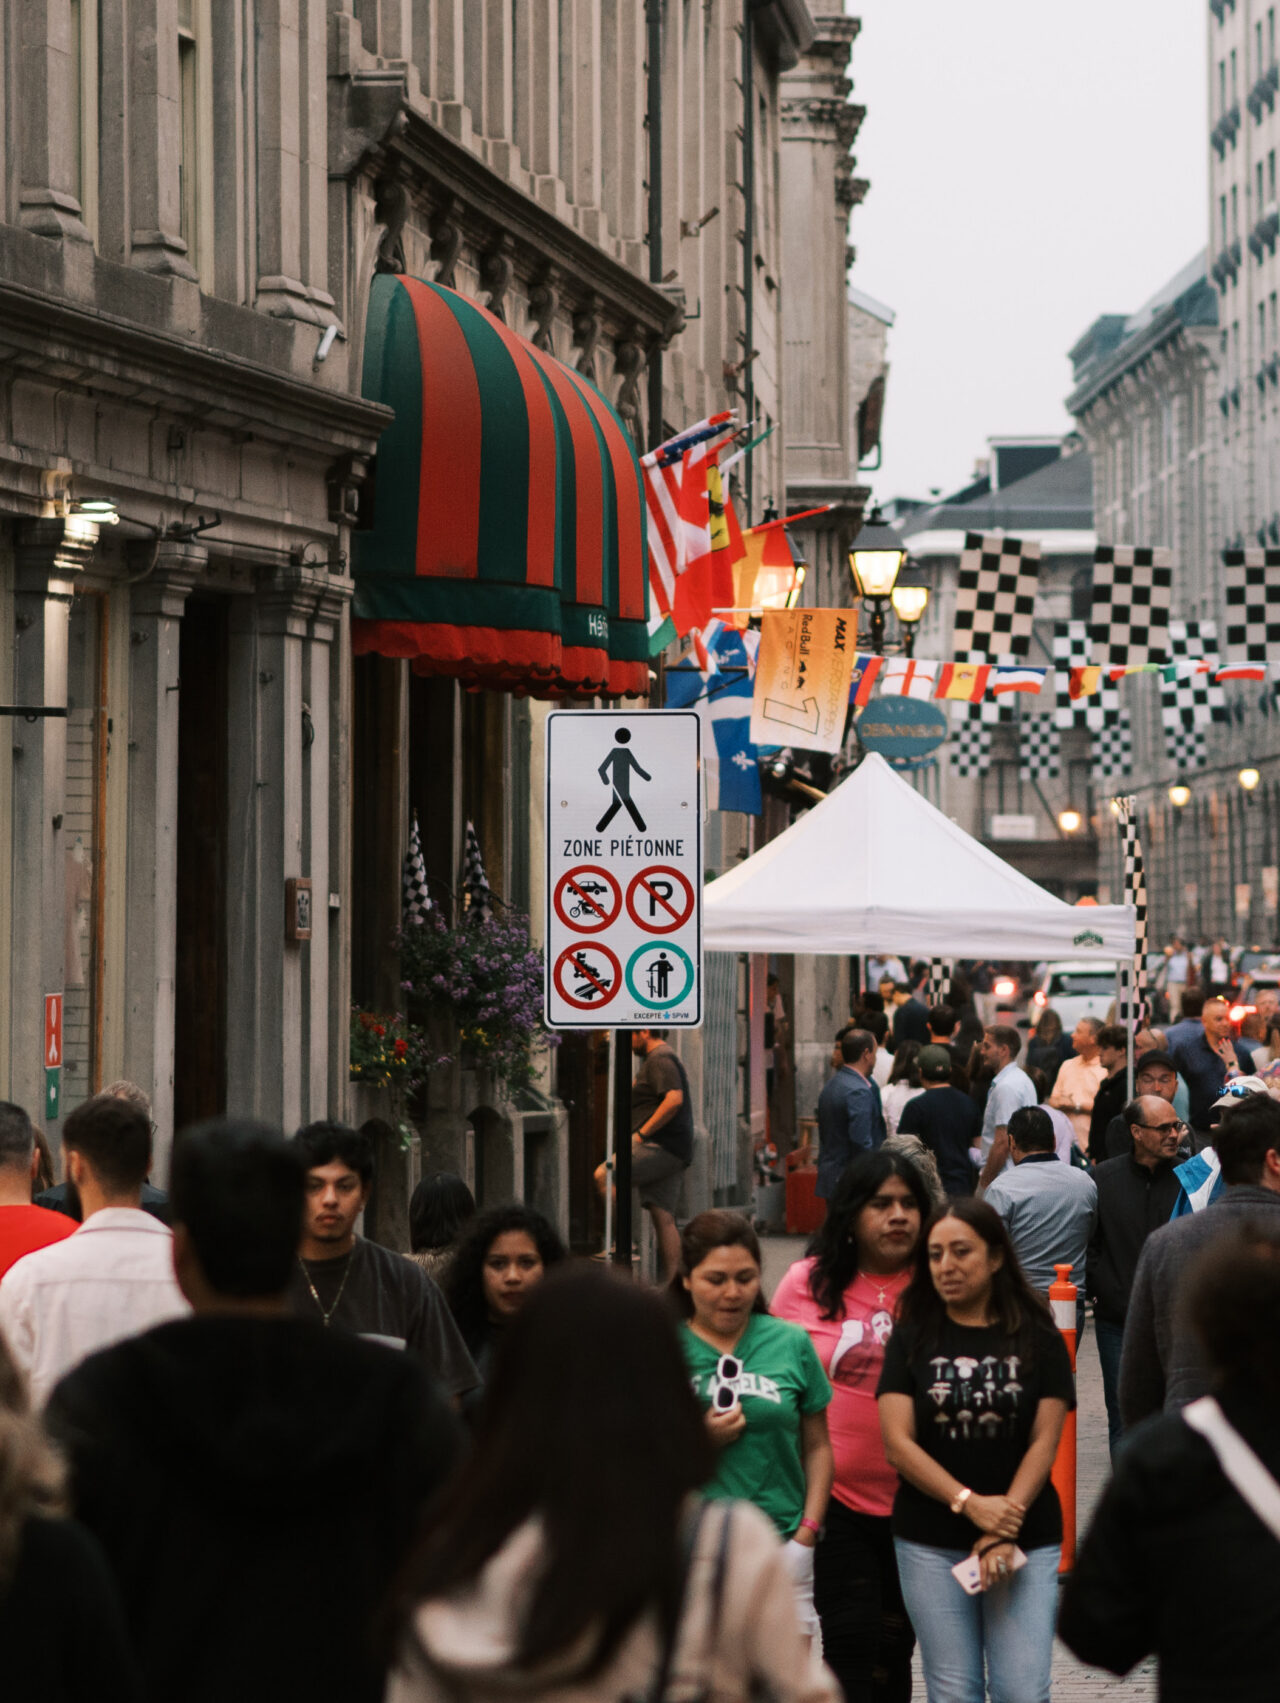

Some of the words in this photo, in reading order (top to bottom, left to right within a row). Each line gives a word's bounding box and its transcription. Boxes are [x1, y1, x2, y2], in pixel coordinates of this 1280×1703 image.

[834, 617, 847, 652] MAX
[563, 839, 602, 857] ZONE
[611, 834, 684, 857] PIÉTONNE
[649, 881, 674, 917] P
